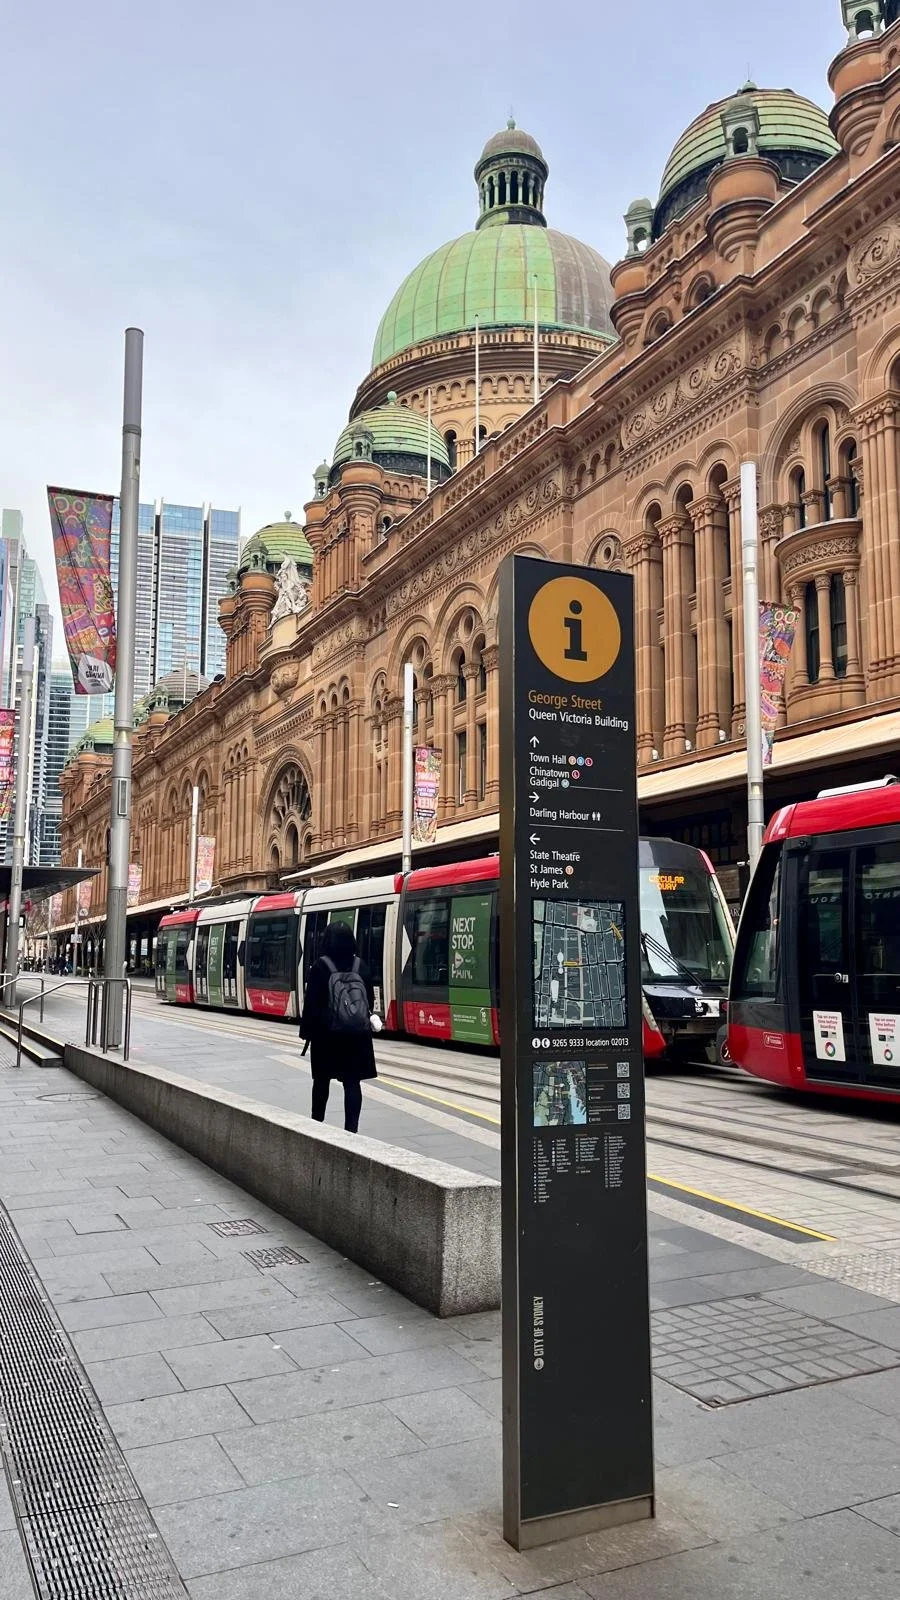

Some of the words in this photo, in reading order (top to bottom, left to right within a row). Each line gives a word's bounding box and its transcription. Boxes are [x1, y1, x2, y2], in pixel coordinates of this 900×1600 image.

[528, 690, 567, 709] George
[571, 695, 602, 710] Street
[528, 708, 557, 721] Queen
[560, 711, 592, 725] Victoria
[595, 715, 629, 731] Building
[529, 752, 550, 763] Town
[552, 754, 567, 764] Hall
[529, 766, 570, 779] Chinatown
[529, 777, 560, 790] Gadigal
[530, 808, 557, 820] Darling
[559, 810, 590, 820] Harbour
[530, 850, 550, 860] State
[552, 850, 580, 861] Theatre
[530, 864, 538, 874] St
[540, 864, 564, 874] James
[530, 878, 550, 890] Hyde
[552, 879, 569, 889] Park
[657, 882, 677, 890] QUAY
[452, 917, 476, 932] NEXT
[552, 1039, 568, 1047] 9265
[568, 1038, 584, 1047] 9333
[586, 1038, 610, 1046] location
[610, 1037, 629, 1046] 02013
[533, 1296, 544, 1326] SYDNEY
[533, 1327, 544, 1337] OF
[533, 1338, 544, 1357] CITY
